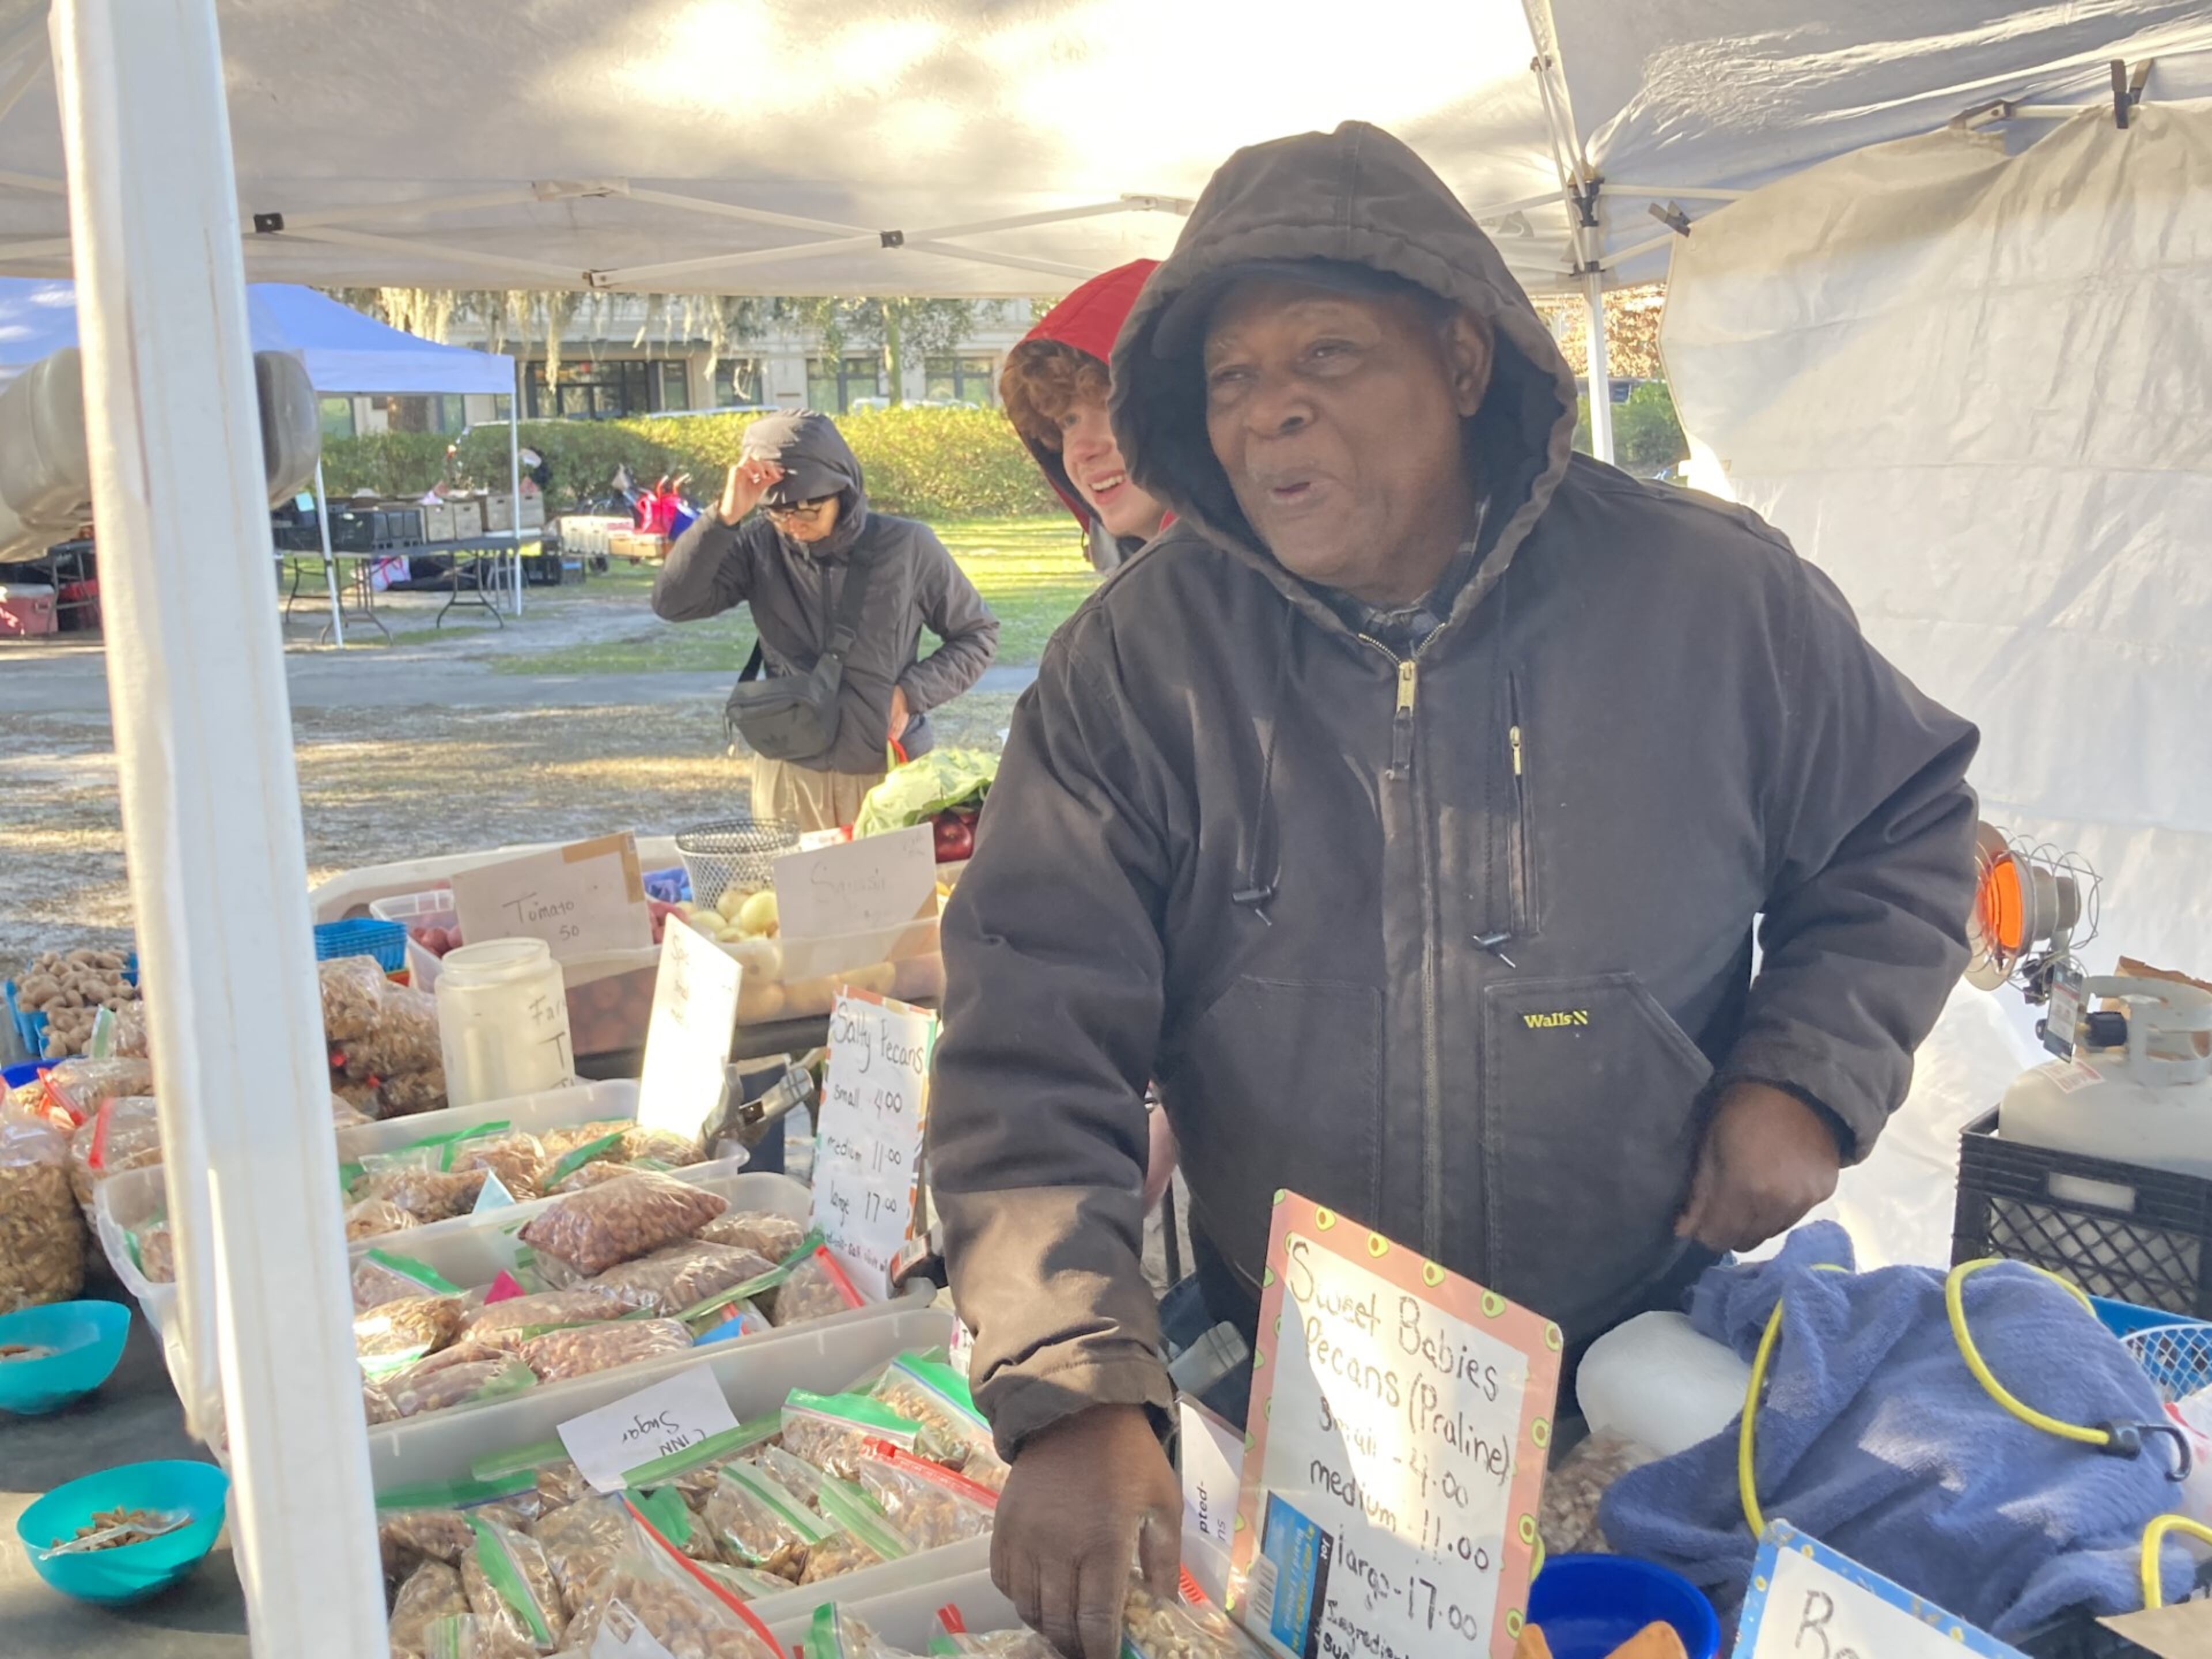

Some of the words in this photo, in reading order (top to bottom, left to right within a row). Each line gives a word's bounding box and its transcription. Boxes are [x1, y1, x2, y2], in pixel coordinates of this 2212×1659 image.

[835, 1001, 870, 1074] Salty
[881, 1019, 924, 1074] Pecans
[1290, 1241, 1381, 1337] Sweet
[1399, 1296, 1499, 1402] Babies
[1306, 1316, 1400, 1407] Pecans
[622, 1411, 680, 1444] Sugar
[1310, 1460, 1396, 1533] medium
